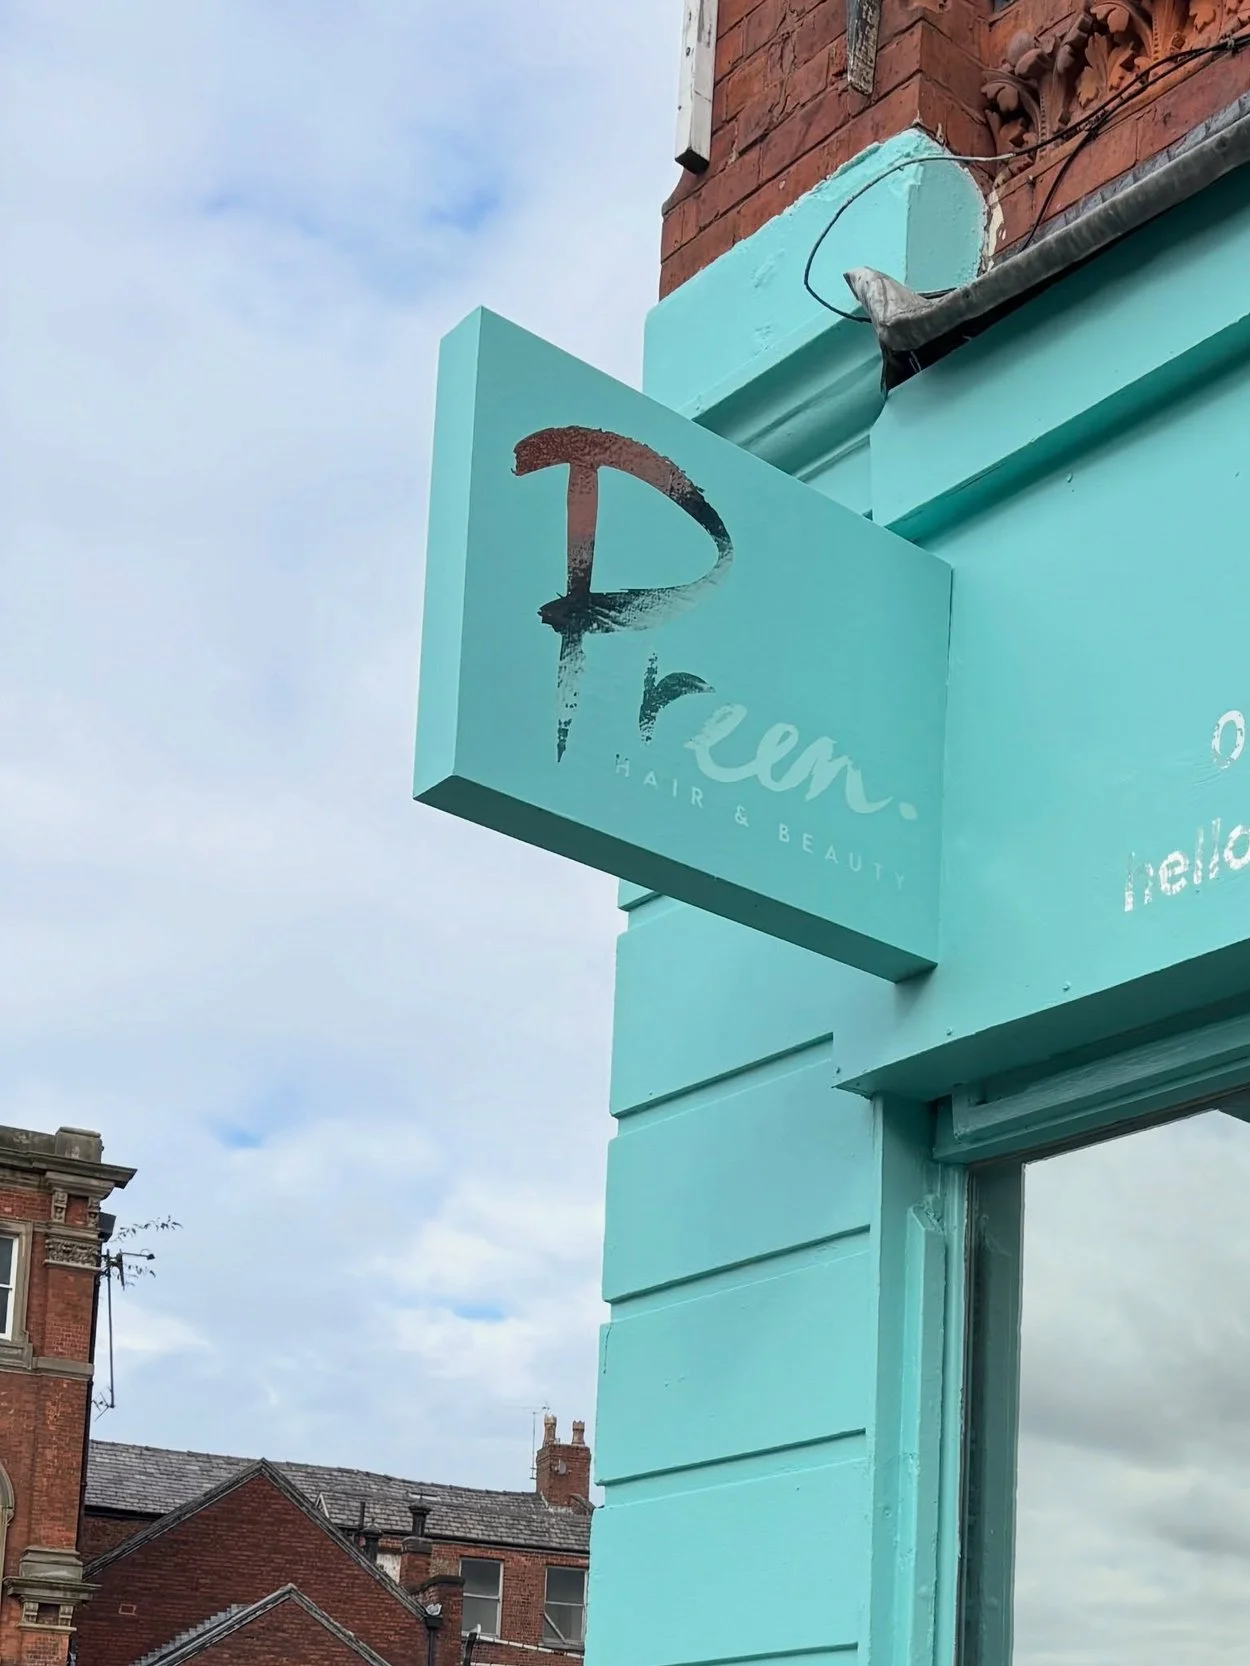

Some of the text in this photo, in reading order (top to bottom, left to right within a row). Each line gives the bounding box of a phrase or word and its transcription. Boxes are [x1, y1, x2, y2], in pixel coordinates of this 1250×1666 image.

[614, 756, 906, 887] HAIR & BEAUTY
